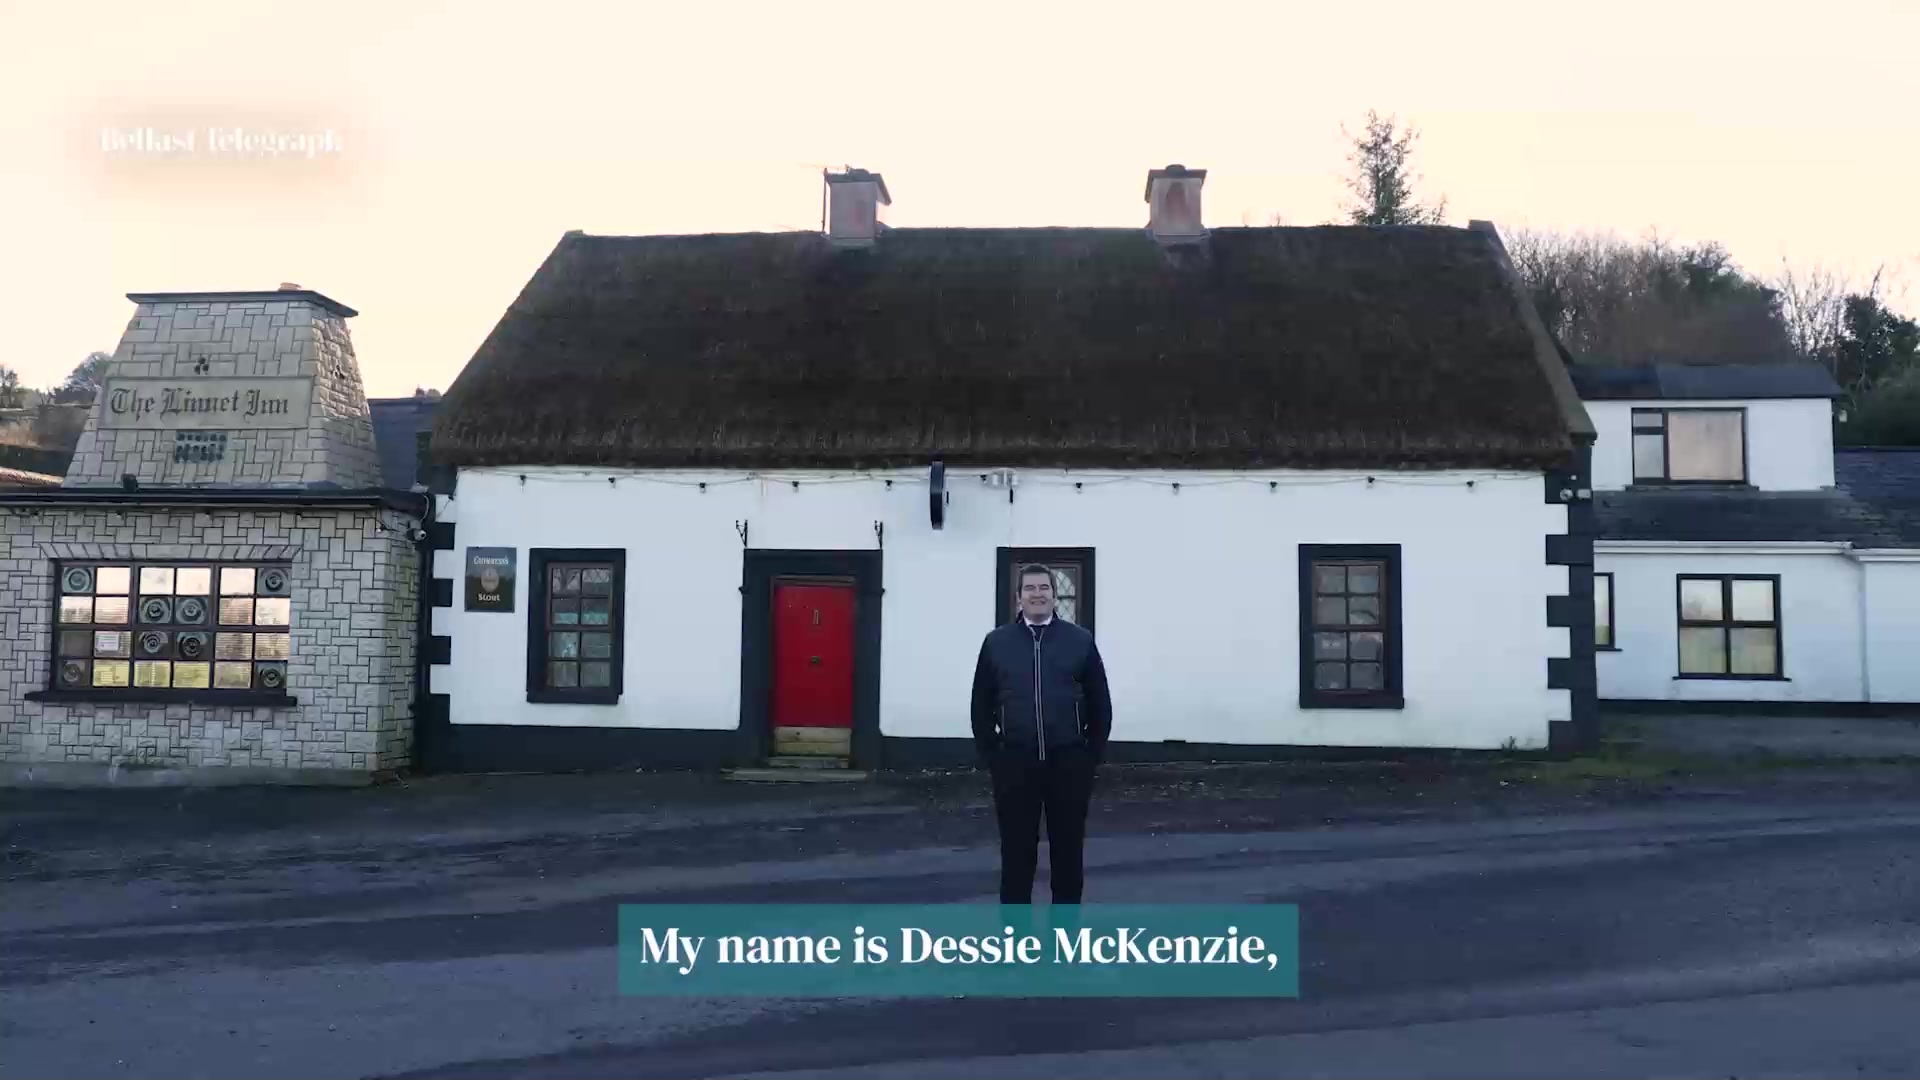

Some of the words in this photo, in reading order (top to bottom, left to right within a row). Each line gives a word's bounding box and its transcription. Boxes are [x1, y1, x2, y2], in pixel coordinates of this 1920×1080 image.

[111, 387, 155, 422] The
[160, 387, 239, 421] Linnet
[243, 389, 288, 424] Inn
[478, 593, 501, 602] Stout
